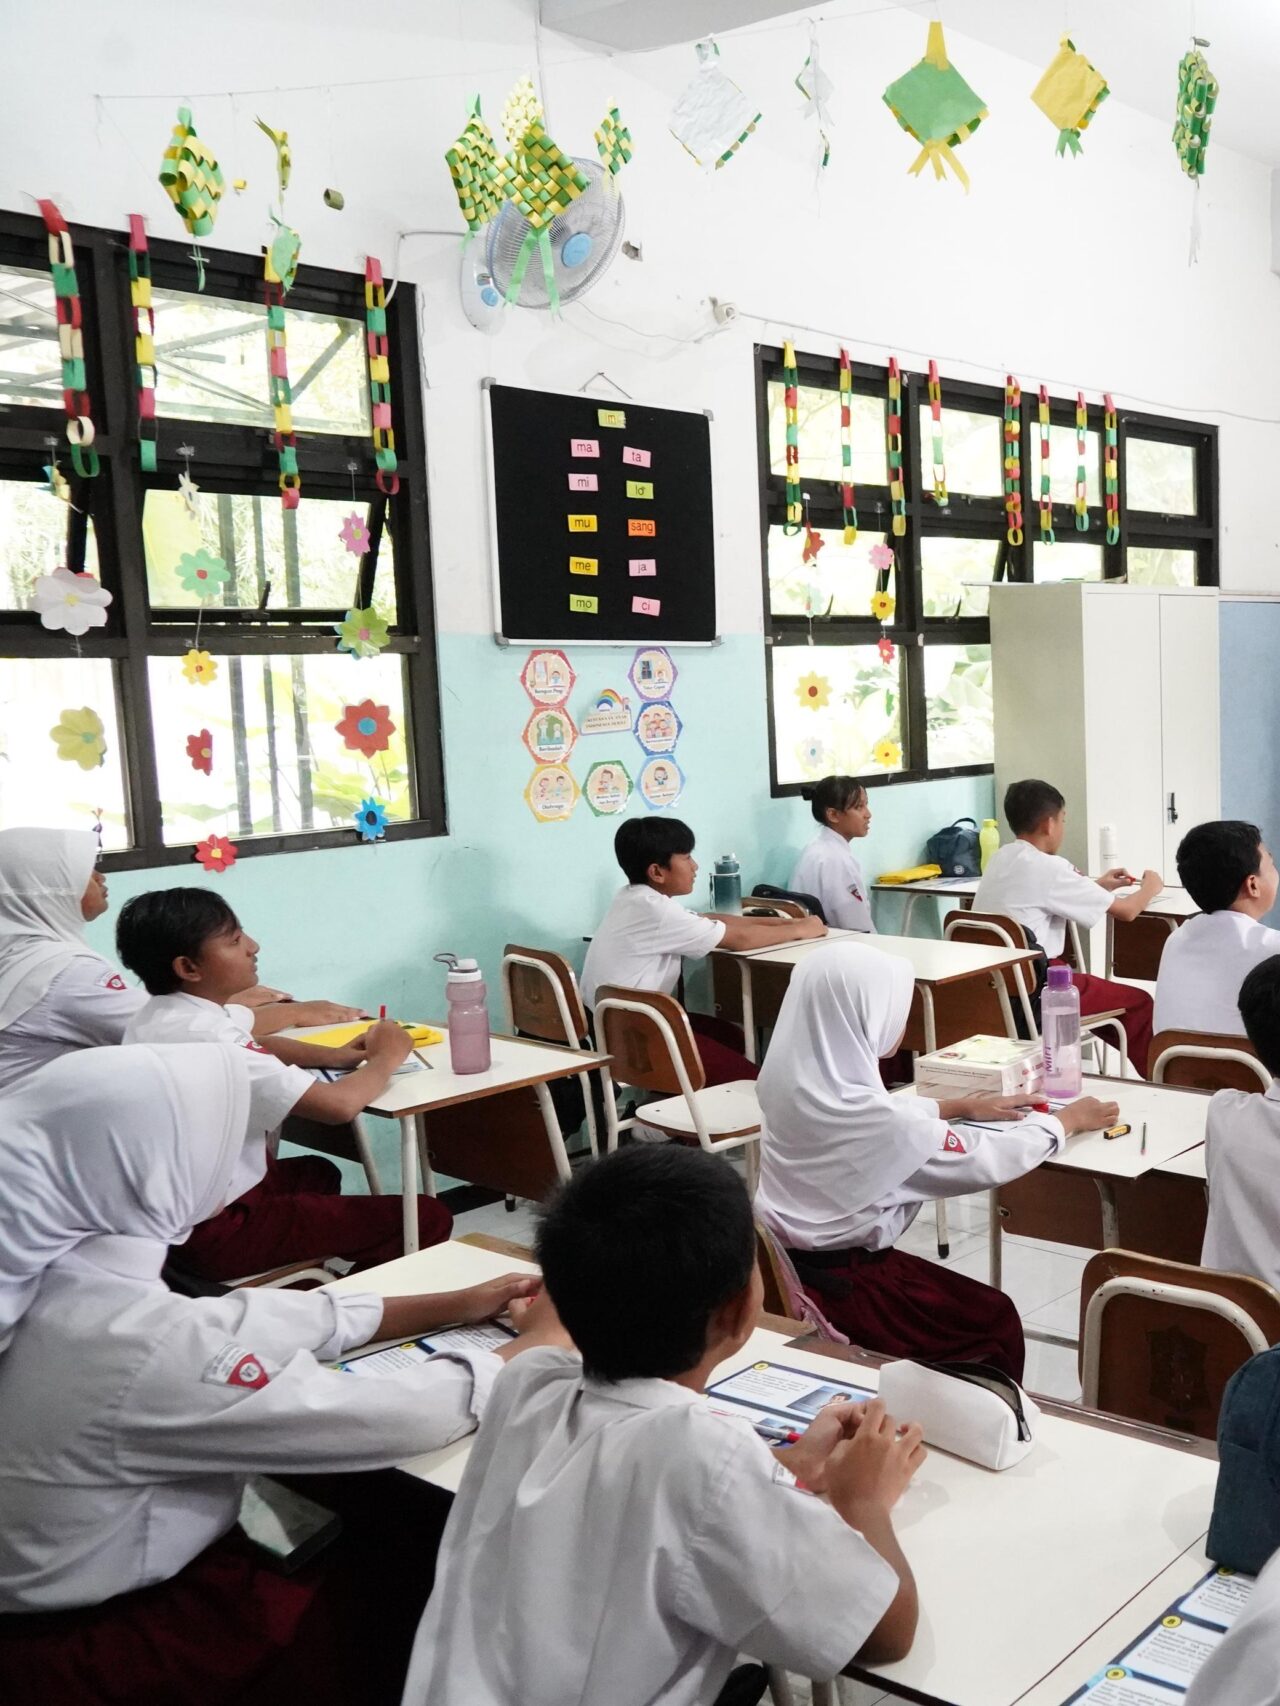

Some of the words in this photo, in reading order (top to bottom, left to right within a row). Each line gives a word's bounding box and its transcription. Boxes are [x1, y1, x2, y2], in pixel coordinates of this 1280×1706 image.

[577, 443, 593, 452] ma
[632, 451, 642, 462] ta
[578, 477, 589, 487] mi
[575, 518, 590, 529] mu
[631, 521, 653, 534] sang
[575, 562, 591, 571] me
[637, 562, 647, 572] ja
[577, 600, 592, 608] mo
